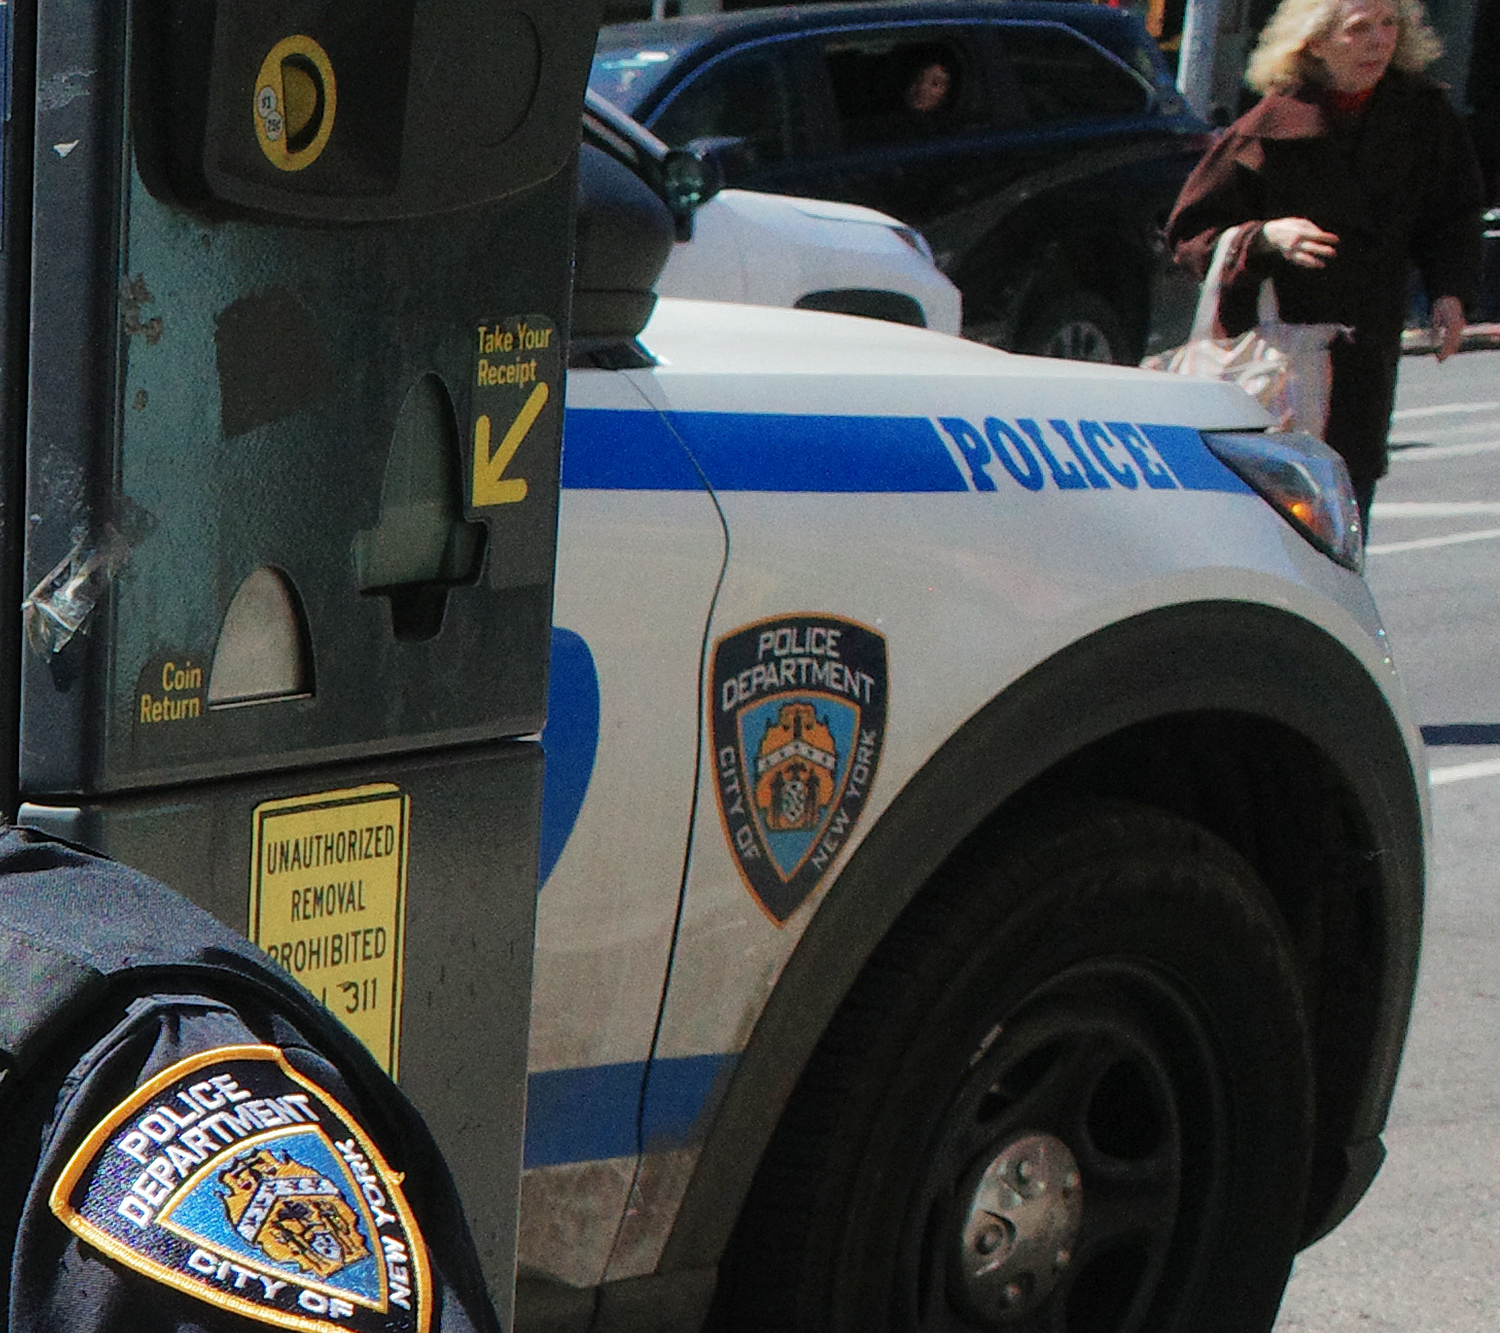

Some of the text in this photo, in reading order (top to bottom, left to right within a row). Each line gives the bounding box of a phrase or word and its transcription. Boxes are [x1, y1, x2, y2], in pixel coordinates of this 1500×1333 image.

[478, 322, 553, 353] Take Your
[477, 356, 537, 388] Receipt
[942, 416, 1173, 492] POLICE
[758, 626, 842, 660] POLICE
[162, 661, 202, 692] Coin
[721, 657, 875, 712] DEPARTMENT
[140, 693, 202, 723] Return
[719, 746, 762, 860] CITY OF
[811, 728, 878, 870] NEW YORK
[266, 824, 395, 876] UNAUTHORIZED
[290, 878, 366, 924] REMOVAL
[115, 1074, 251, 1164] POLICE
[116, 1093, 321, 1231] DEPARTMENT
[188, 1249, 355, 1319] CITY OF
[384, 1236, 414, 1310] NEW
